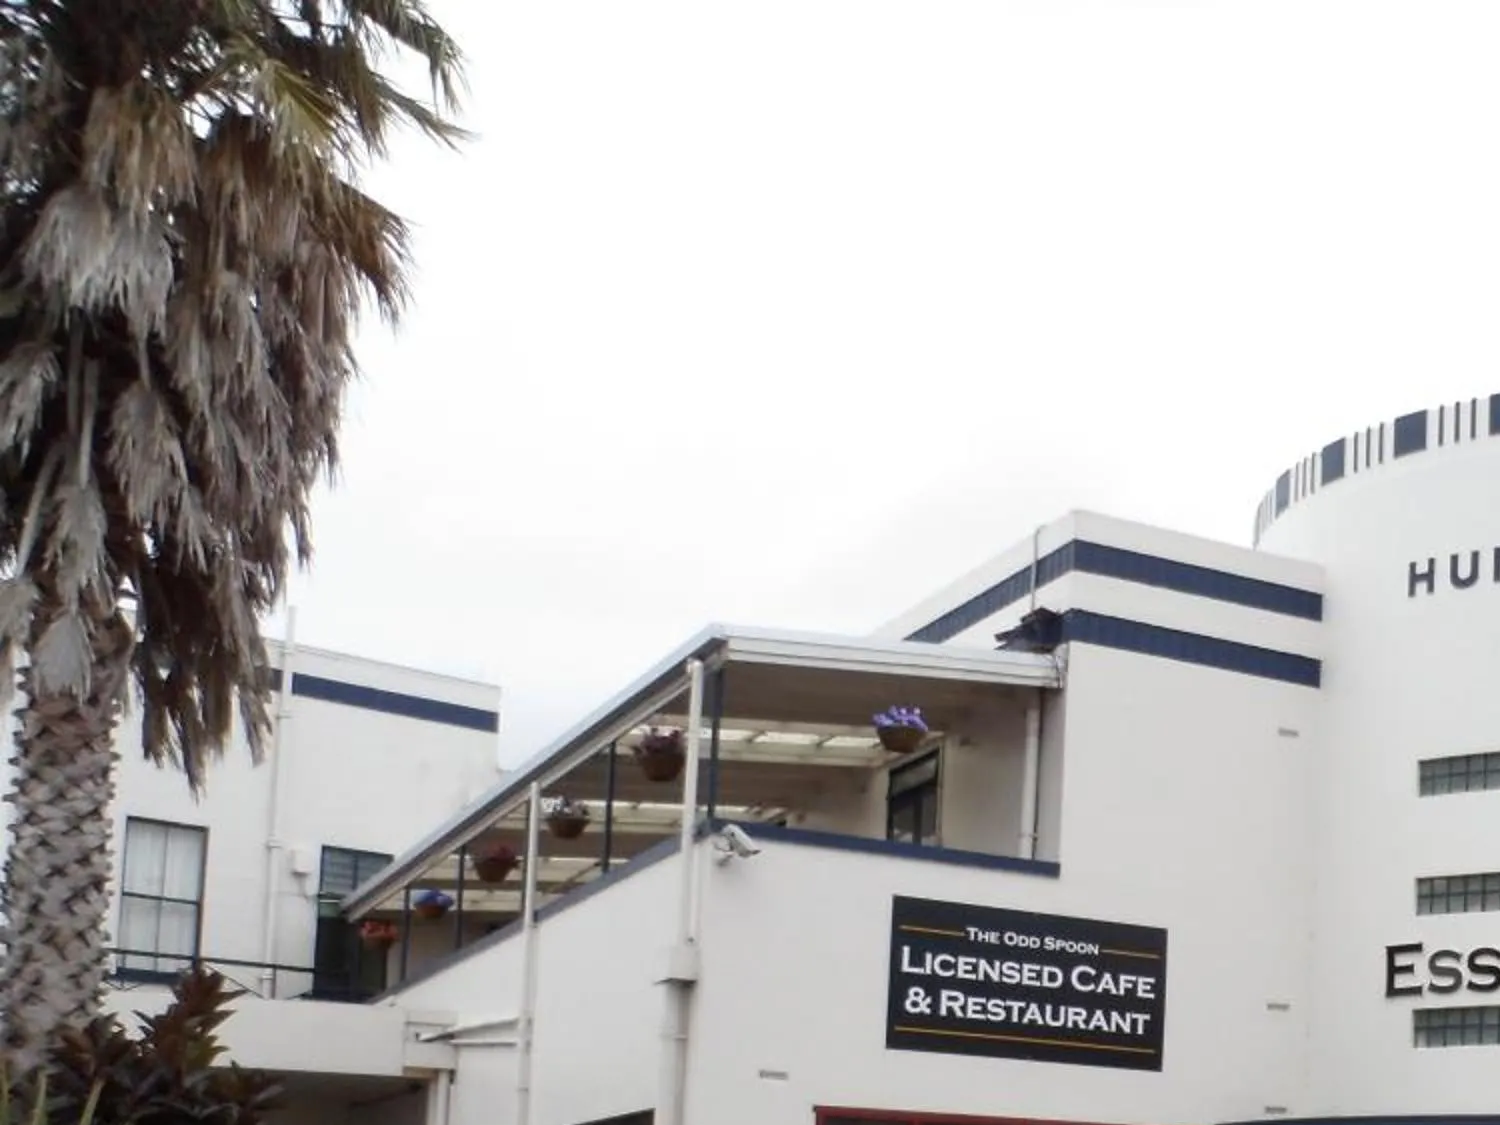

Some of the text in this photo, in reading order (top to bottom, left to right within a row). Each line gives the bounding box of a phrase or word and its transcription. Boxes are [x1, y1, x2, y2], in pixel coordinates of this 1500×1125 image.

[965, 926, 1100, 956] THE ODD SPOON
[900, 945, 1156, 1000] LICENSED CAFE
[903, 986, 1152, 1036] & RESTAURANT
